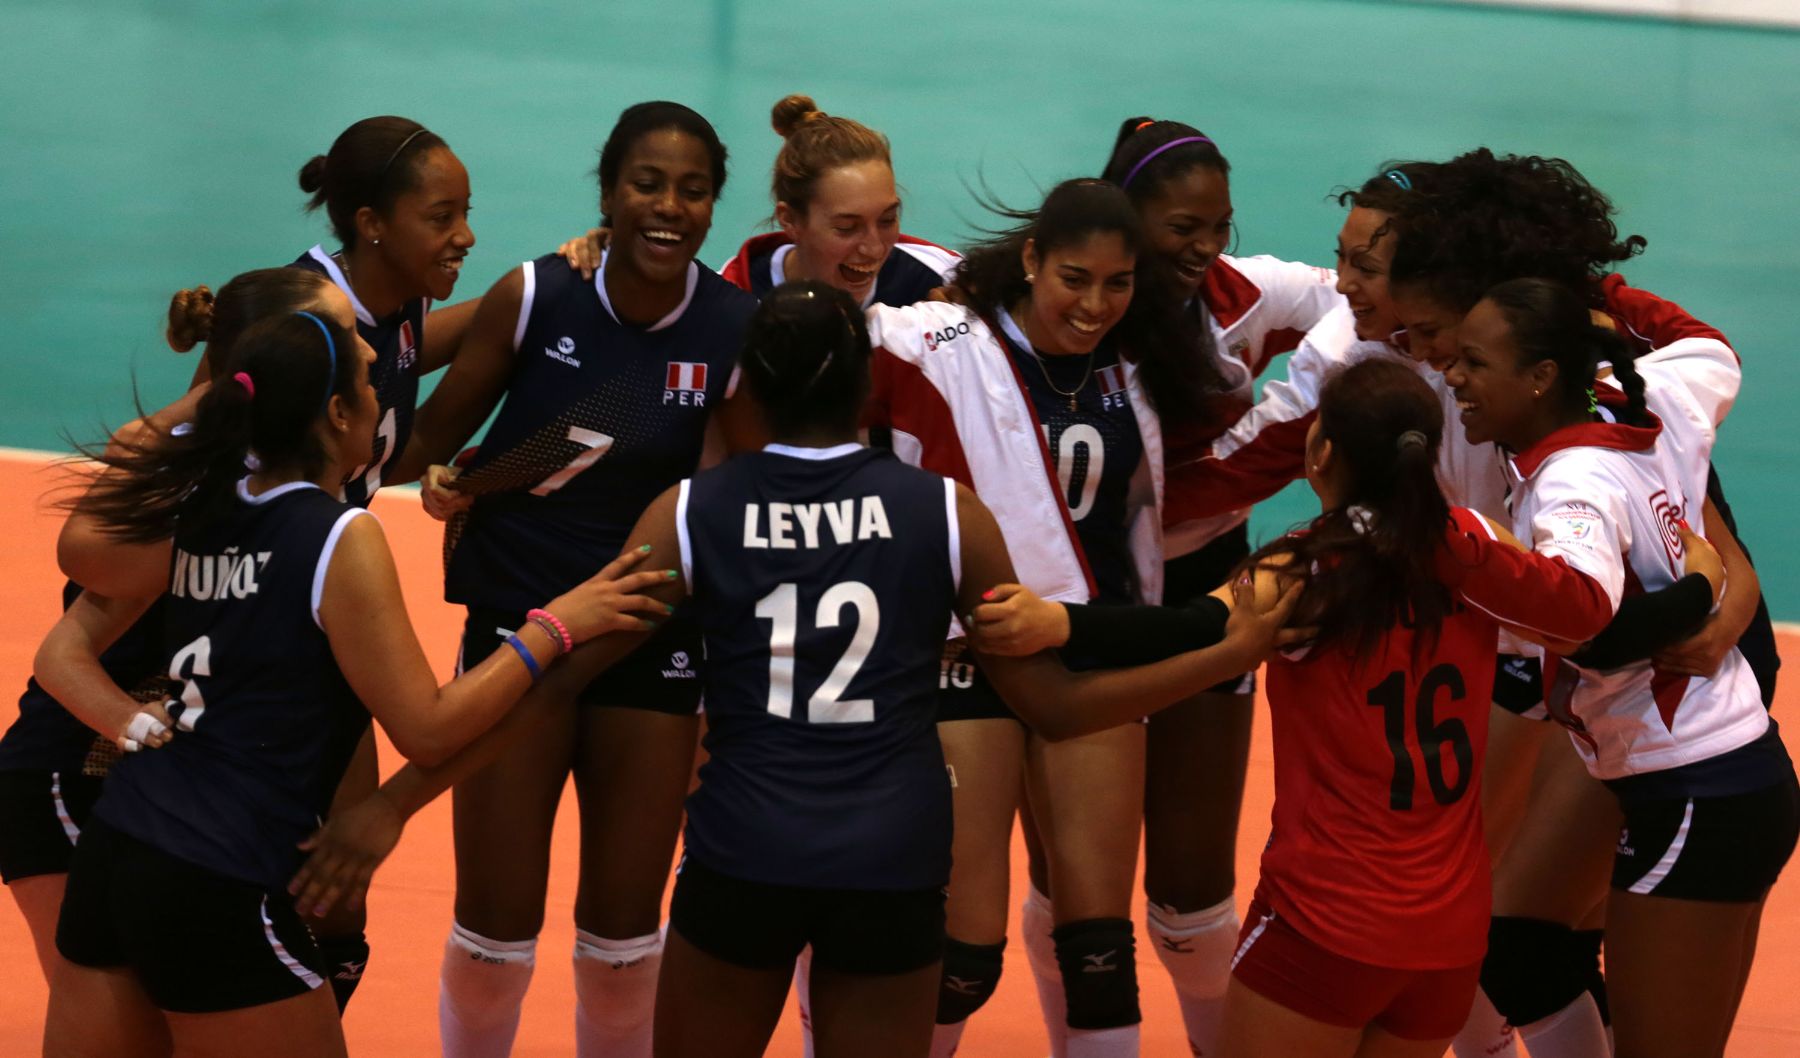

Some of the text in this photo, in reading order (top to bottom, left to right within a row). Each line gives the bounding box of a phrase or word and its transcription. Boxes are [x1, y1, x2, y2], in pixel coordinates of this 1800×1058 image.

[662, 390, 706, 408] PER
[1101, 393, 1129, 412] PE
[528, 425, 615, 497] 7
[1040, 423, 1105, 522] 0
[743, 495, 893, 549] LEYVA
[754, 580, 881, 724] 12
[1367, 663, 1474, 810] 16
